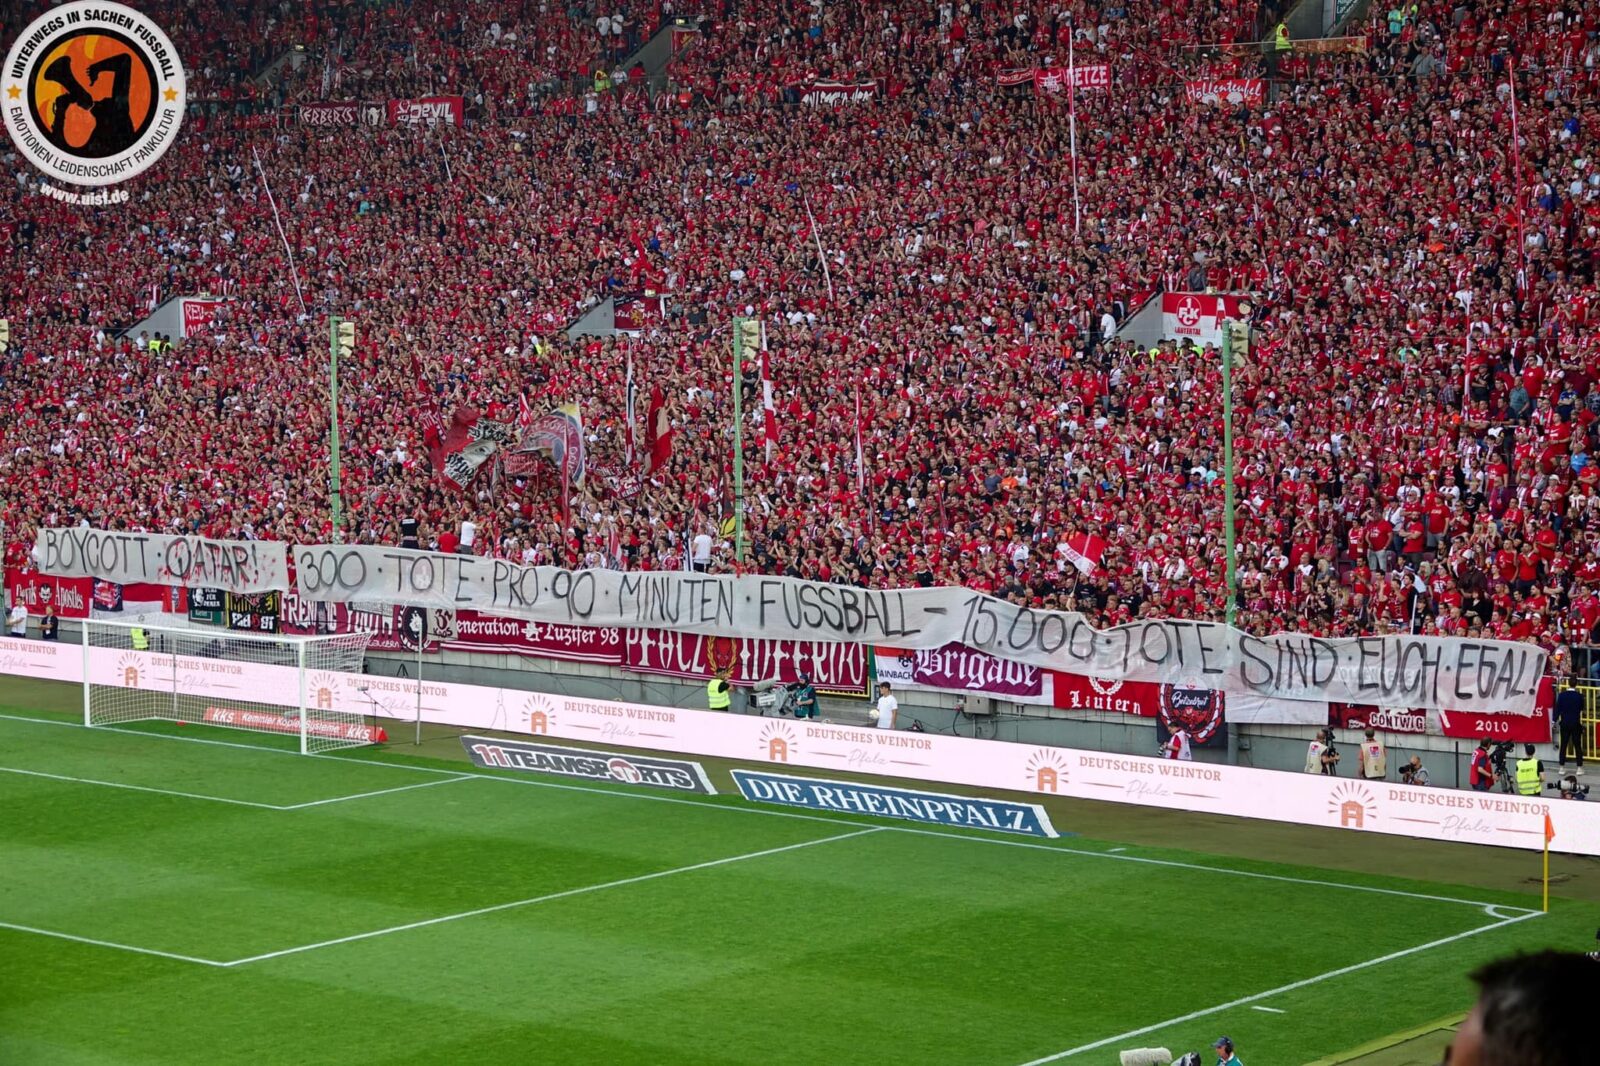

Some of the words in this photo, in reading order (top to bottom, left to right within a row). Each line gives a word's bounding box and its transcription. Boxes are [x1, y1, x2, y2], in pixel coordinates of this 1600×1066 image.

[45, 529, 149, 578] BOYCOTT
[165, 537, 258, 587] QATAR!
[54, 576, 84, 615] Apostles
[300, 550, 367, 592] 300
[384, 553, 475, 601] TOTE
[493, 560, 539, 608] PRO
[552, 569, 596, 619] 90
[618, 574, 734, 627] MINUTEN
[760, 580, 921, 637] FUSSBALL
[960, 594, 1097, 660] 15.000
[1107, 621, 1225, 674] TOTE
[1239, 634, 1338, 691] SIND
[1358, 637, 1442, 703] EUCH
[1454, 643, 1545, 699] EGAL!
[457, 618, 519, 637] eneration
[543, 623, 596, 647] Luzifer
[151, 656, 200, 671] DEUTSCHES
[201, 662, 243, 676] WEINTOR
[626, 628, 706, 674] PFALZ
[740, 638, 866, 685] INFERNO
[914, 648, 1038, 688] Brigade
[564, 701, 624, 717] DEUTSCHES
[626, 708, 676, 723] WEINTOR
[1070, 690, 1141, 715] Lautern
[601, 721, 636, 738] Pfalz
[1369, 712, 1425, 732] CONTWIG
[1475, 720, 1509, 733] 2010
[806, 727, 873, 744] DEUTSCHES
[876, 735, 932, 750] WEINTOR
[848, 748, 888, 767] Pfalz
[1079, 756, 1154, 774] DEUTSCHES
[1159, 764, 1221, 782] WEINTOR
[1126, 779, 1169, 797] Pfalz
[745, 777, 808, 804] DIE
[810, 785, 1033, 832] RHEINPFALZ
[1389, 789, 1474, 808] DEUTSCHES
[1479, 798, 1549, 816] WEINTOR
[1441, 814, 1491, 836] Pfalz
